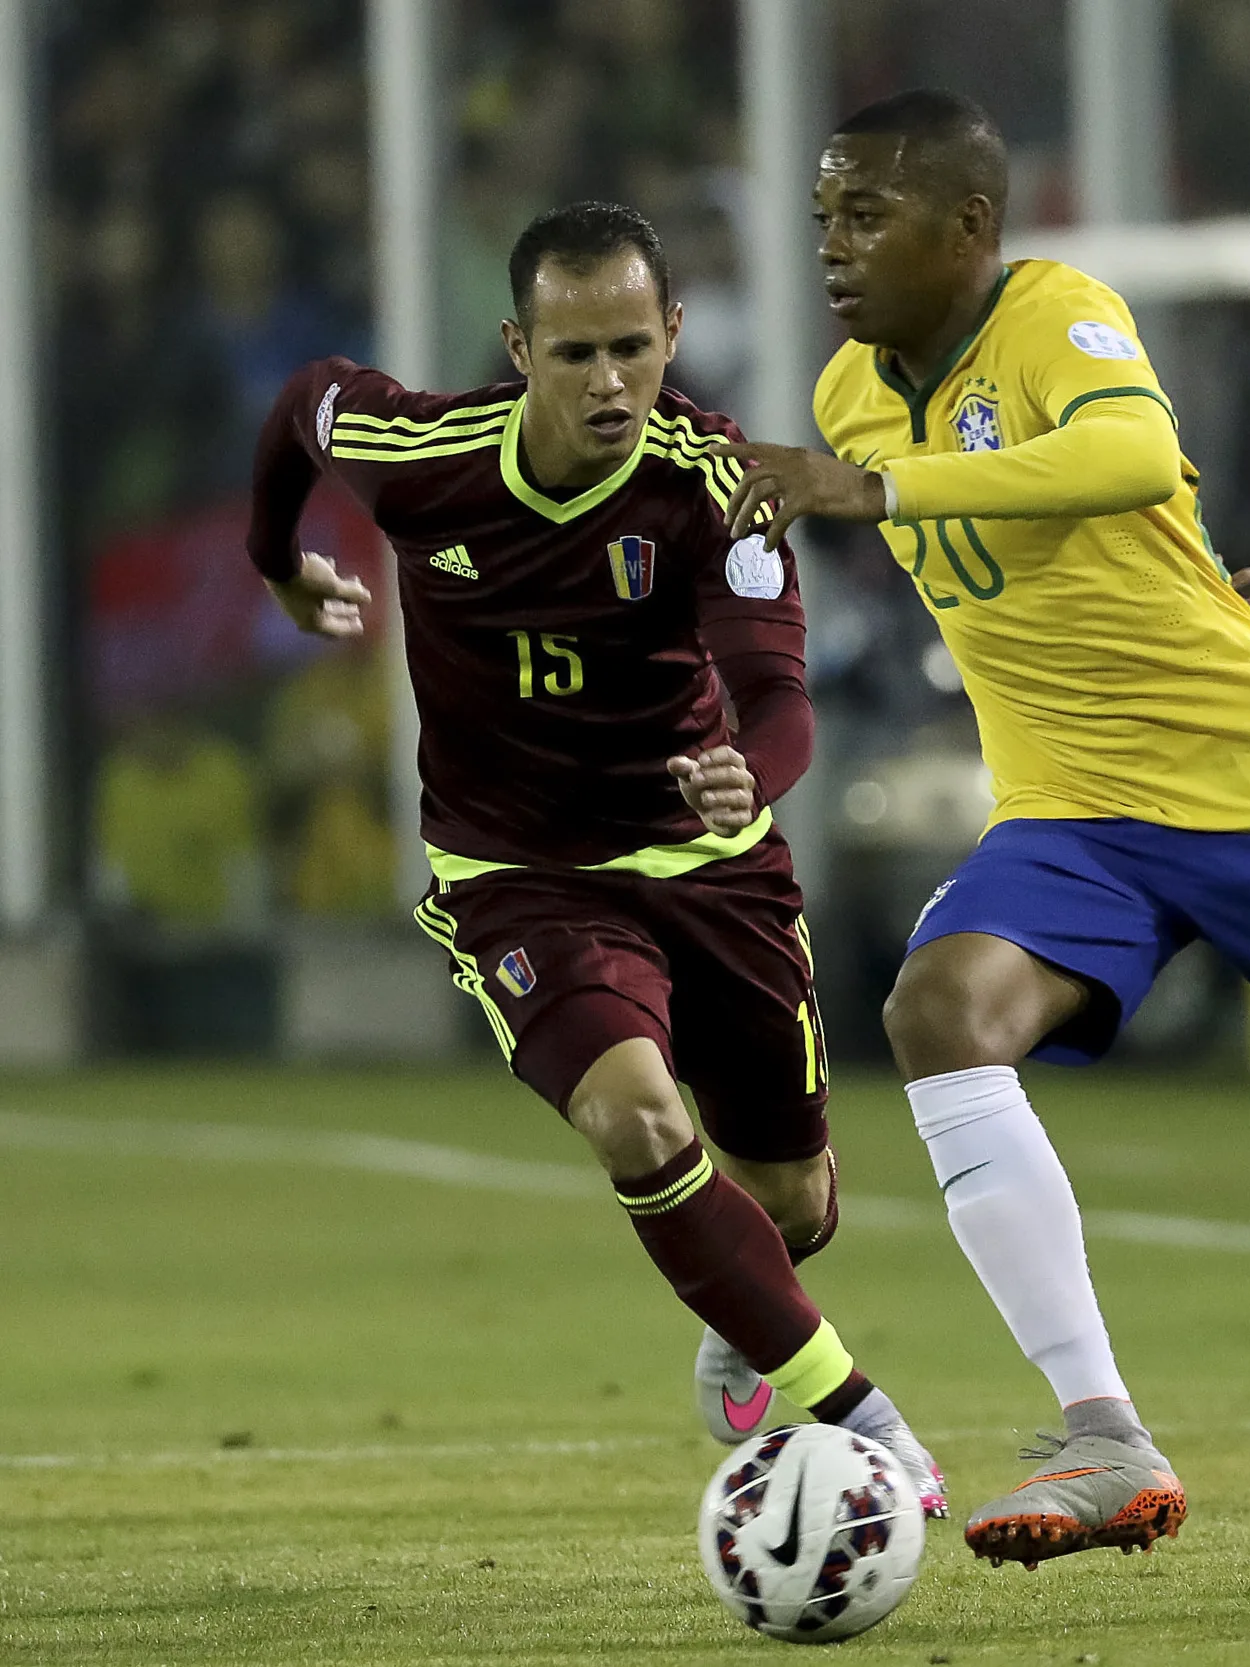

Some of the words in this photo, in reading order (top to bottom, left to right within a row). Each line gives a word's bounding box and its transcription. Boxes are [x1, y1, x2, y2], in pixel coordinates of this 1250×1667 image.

[430, 556, 479, 580] adidas
[892, 517, 1004, 609] 20
[506, 630, 583, 698] 15
